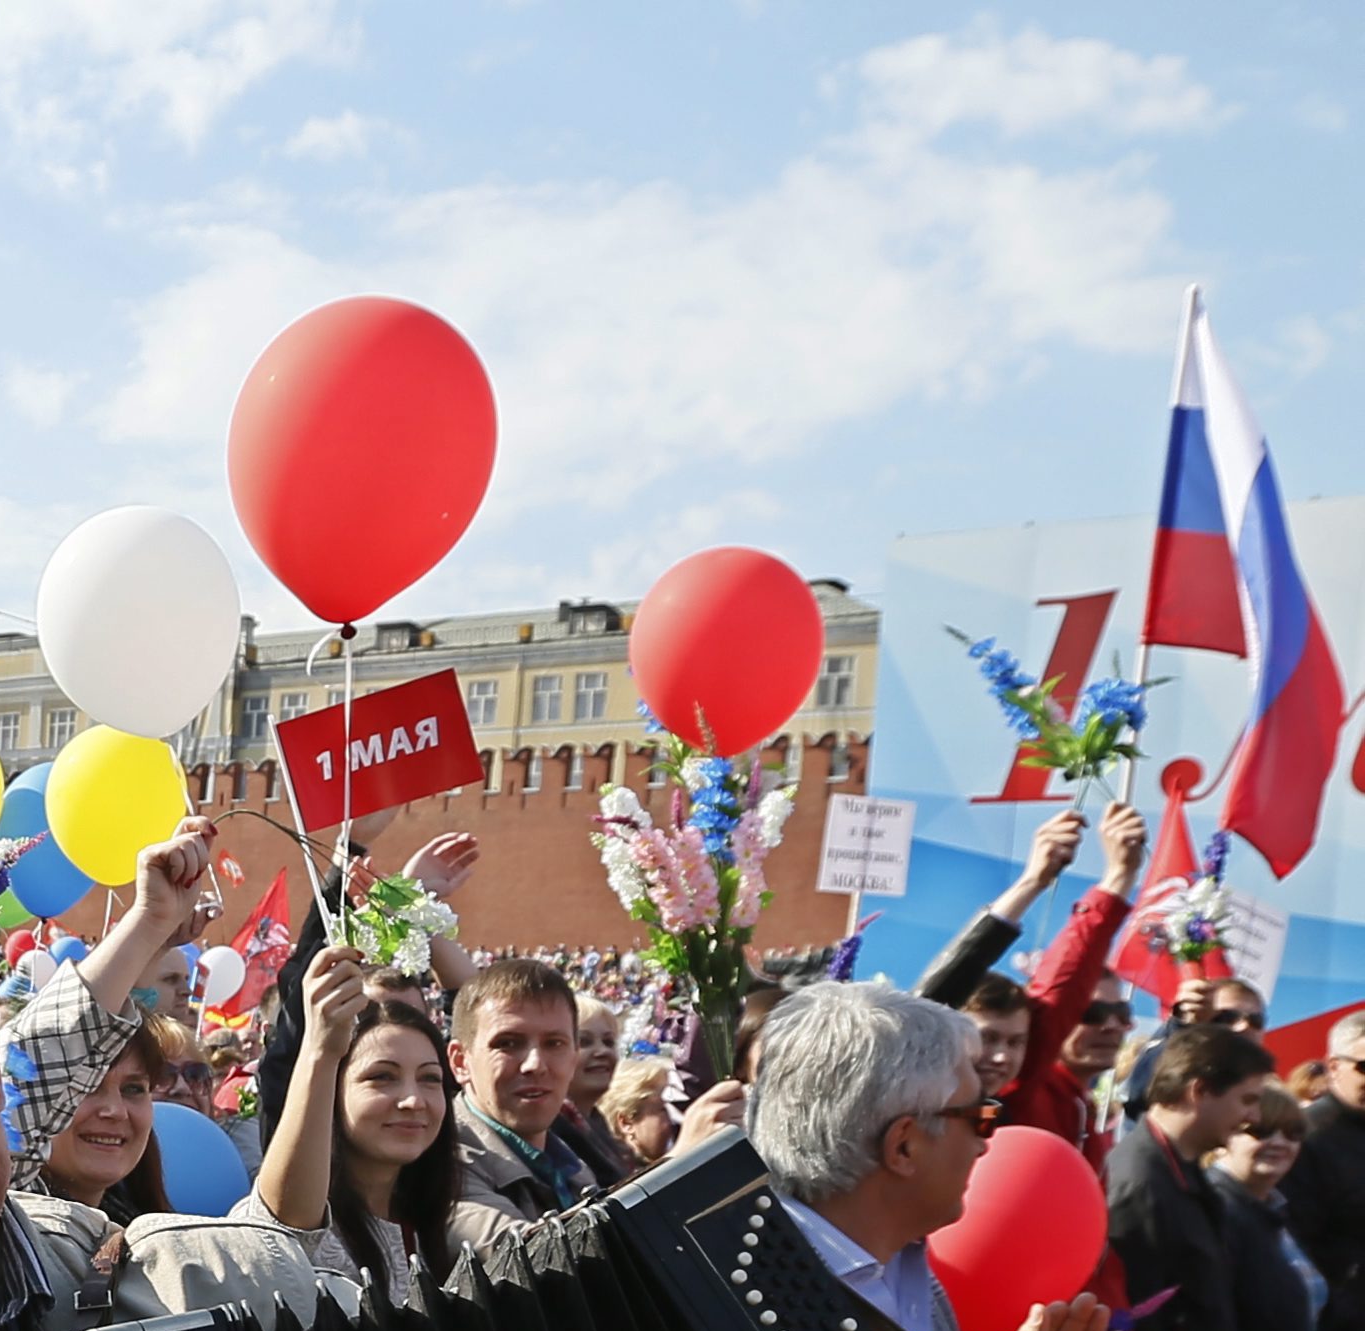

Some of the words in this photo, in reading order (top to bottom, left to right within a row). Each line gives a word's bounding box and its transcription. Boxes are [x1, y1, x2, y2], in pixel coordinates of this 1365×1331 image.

[316, 750, 333, 781] 1
[350, 716, 439, 772] МАЯ
[830, 871, 894, 890] МОСКВА!
